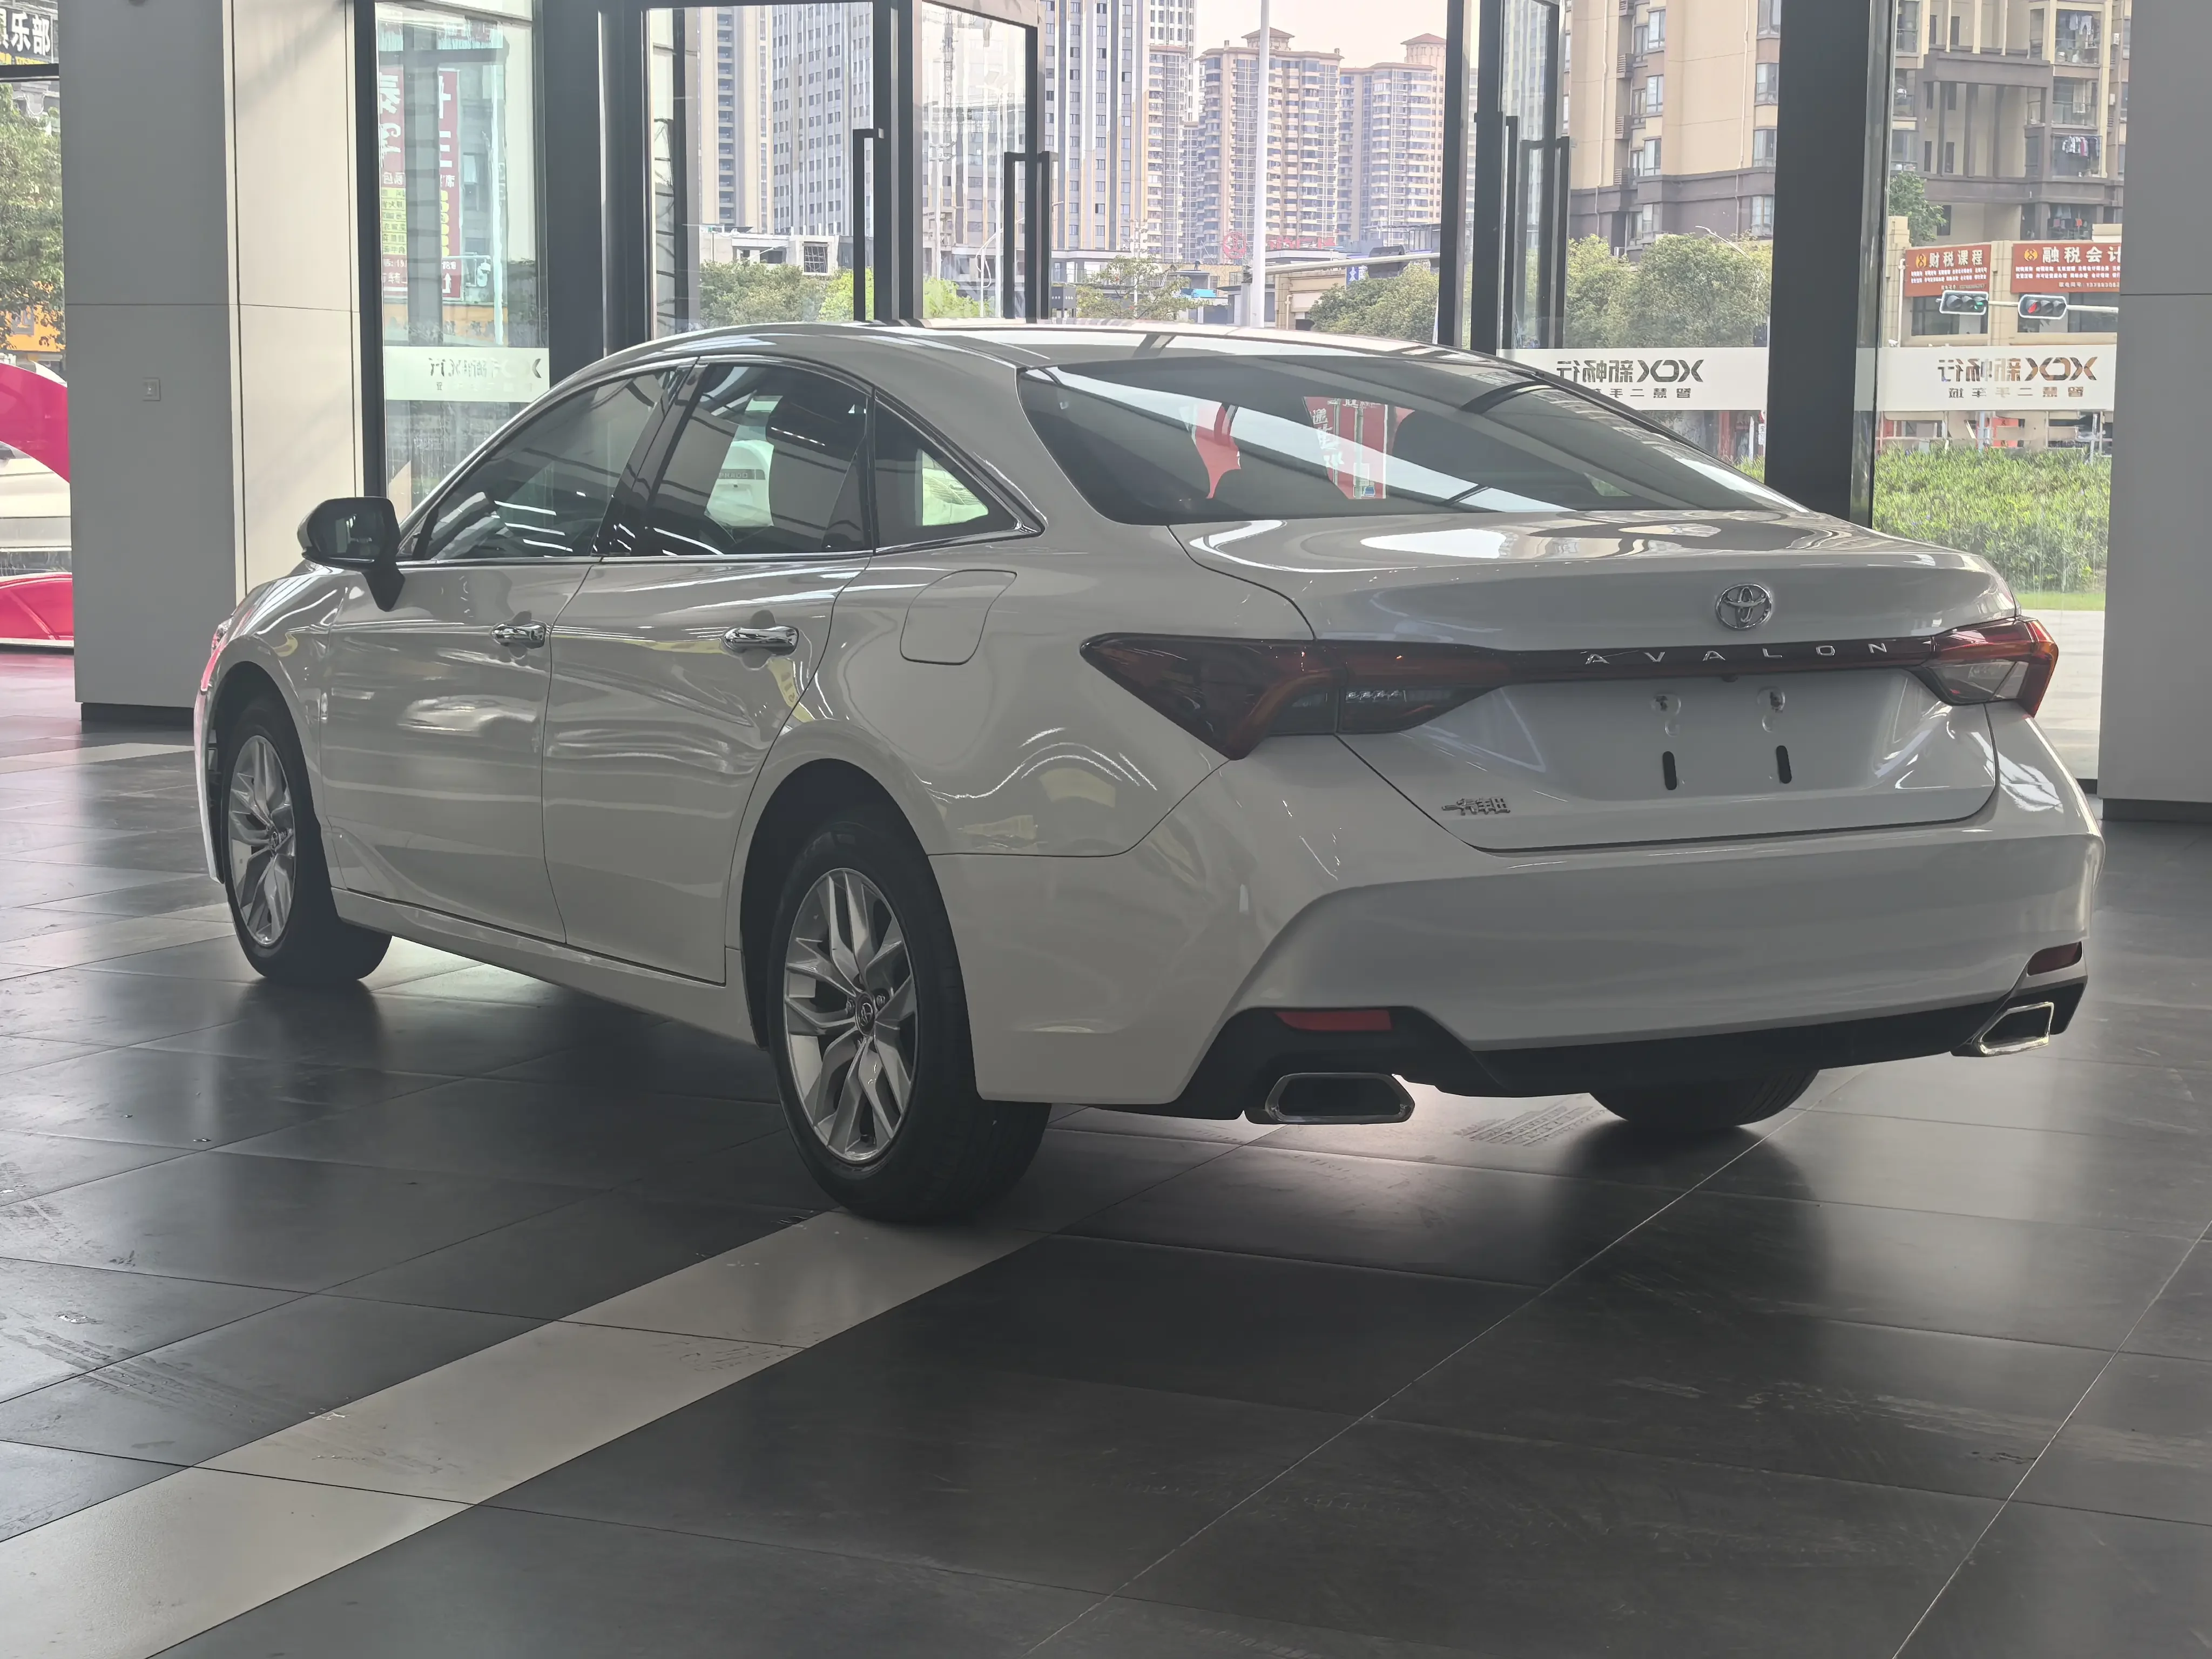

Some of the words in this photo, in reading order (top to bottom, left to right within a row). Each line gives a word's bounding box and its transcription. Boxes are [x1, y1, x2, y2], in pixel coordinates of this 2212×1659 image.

[1928, 249, 1983, 268] 财税课程
[2042, 246, 2121, 264] 融税会计
[1586, 643, 1887, 664] AVALON
